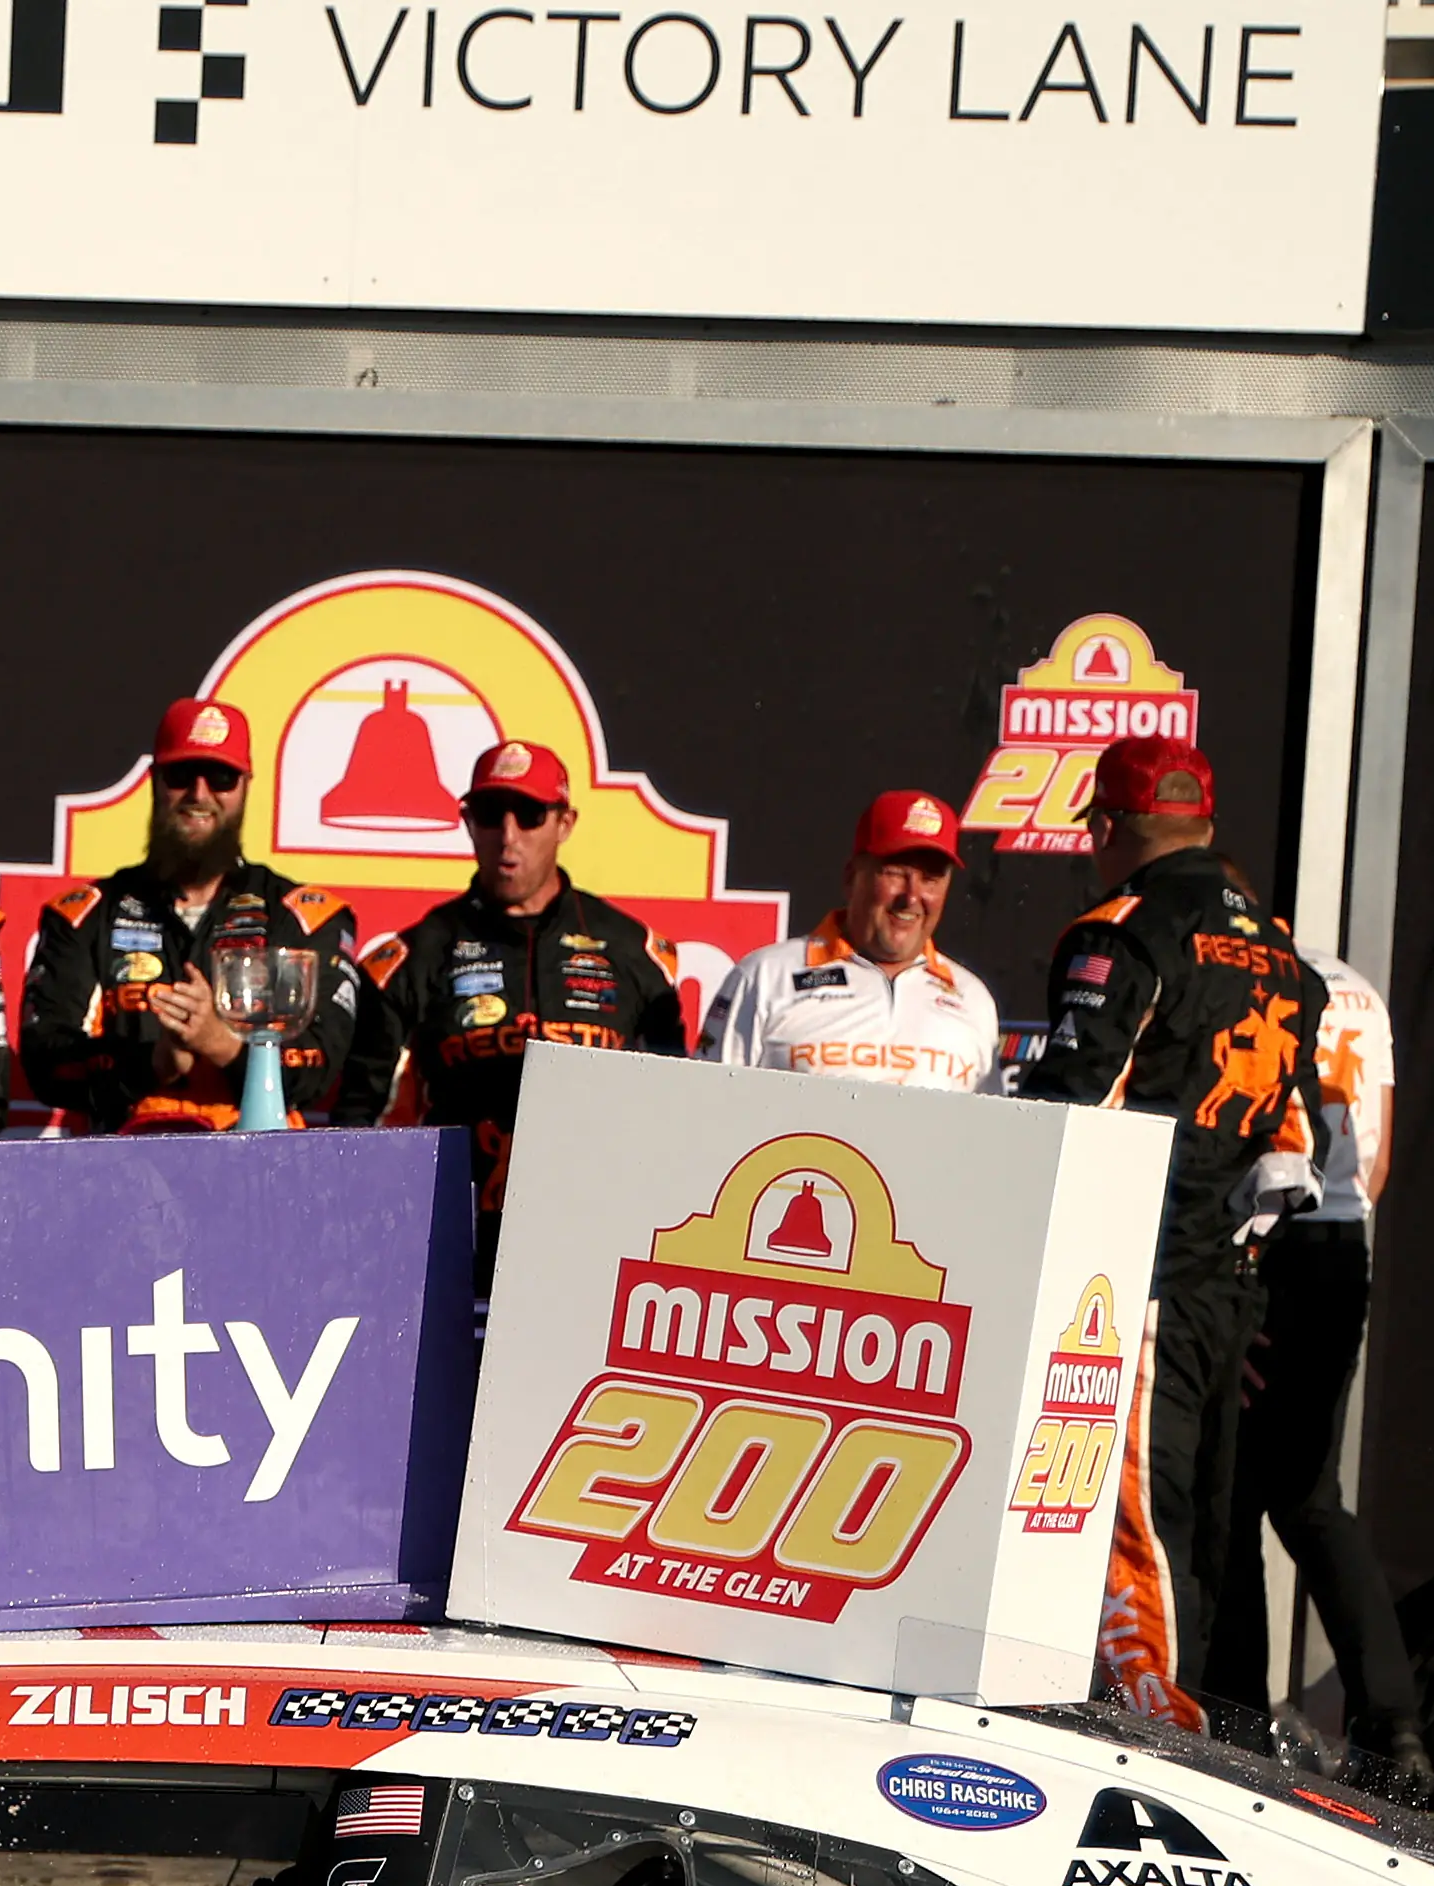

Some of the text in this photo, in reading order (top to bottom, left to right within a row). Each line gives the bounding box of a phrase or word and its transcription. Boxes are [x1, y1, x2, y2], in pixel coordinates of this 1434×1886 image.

[324, 0, 1301, 128] VICTORY LANE
[790, 1042, 981, 1087] REGISTIX
[622, 1282, 950, 1395] MISSION
[1045, 1363, 1120, 1406] MISSION
[520, 1381, 964, 1581] 200
[1011, 1419, 1116, 1509] 200
[1030, 1511, 1078, 1529] AT THE GLEN
[605, 1552, 814, 1608] AT THE GLEN
[8, 1686, 249, 1728] ZILISCH
[889, 1776, 1038, 1811] CHRIS RASCHKE
[931, 1805, 998, 1820] 1964-2025
